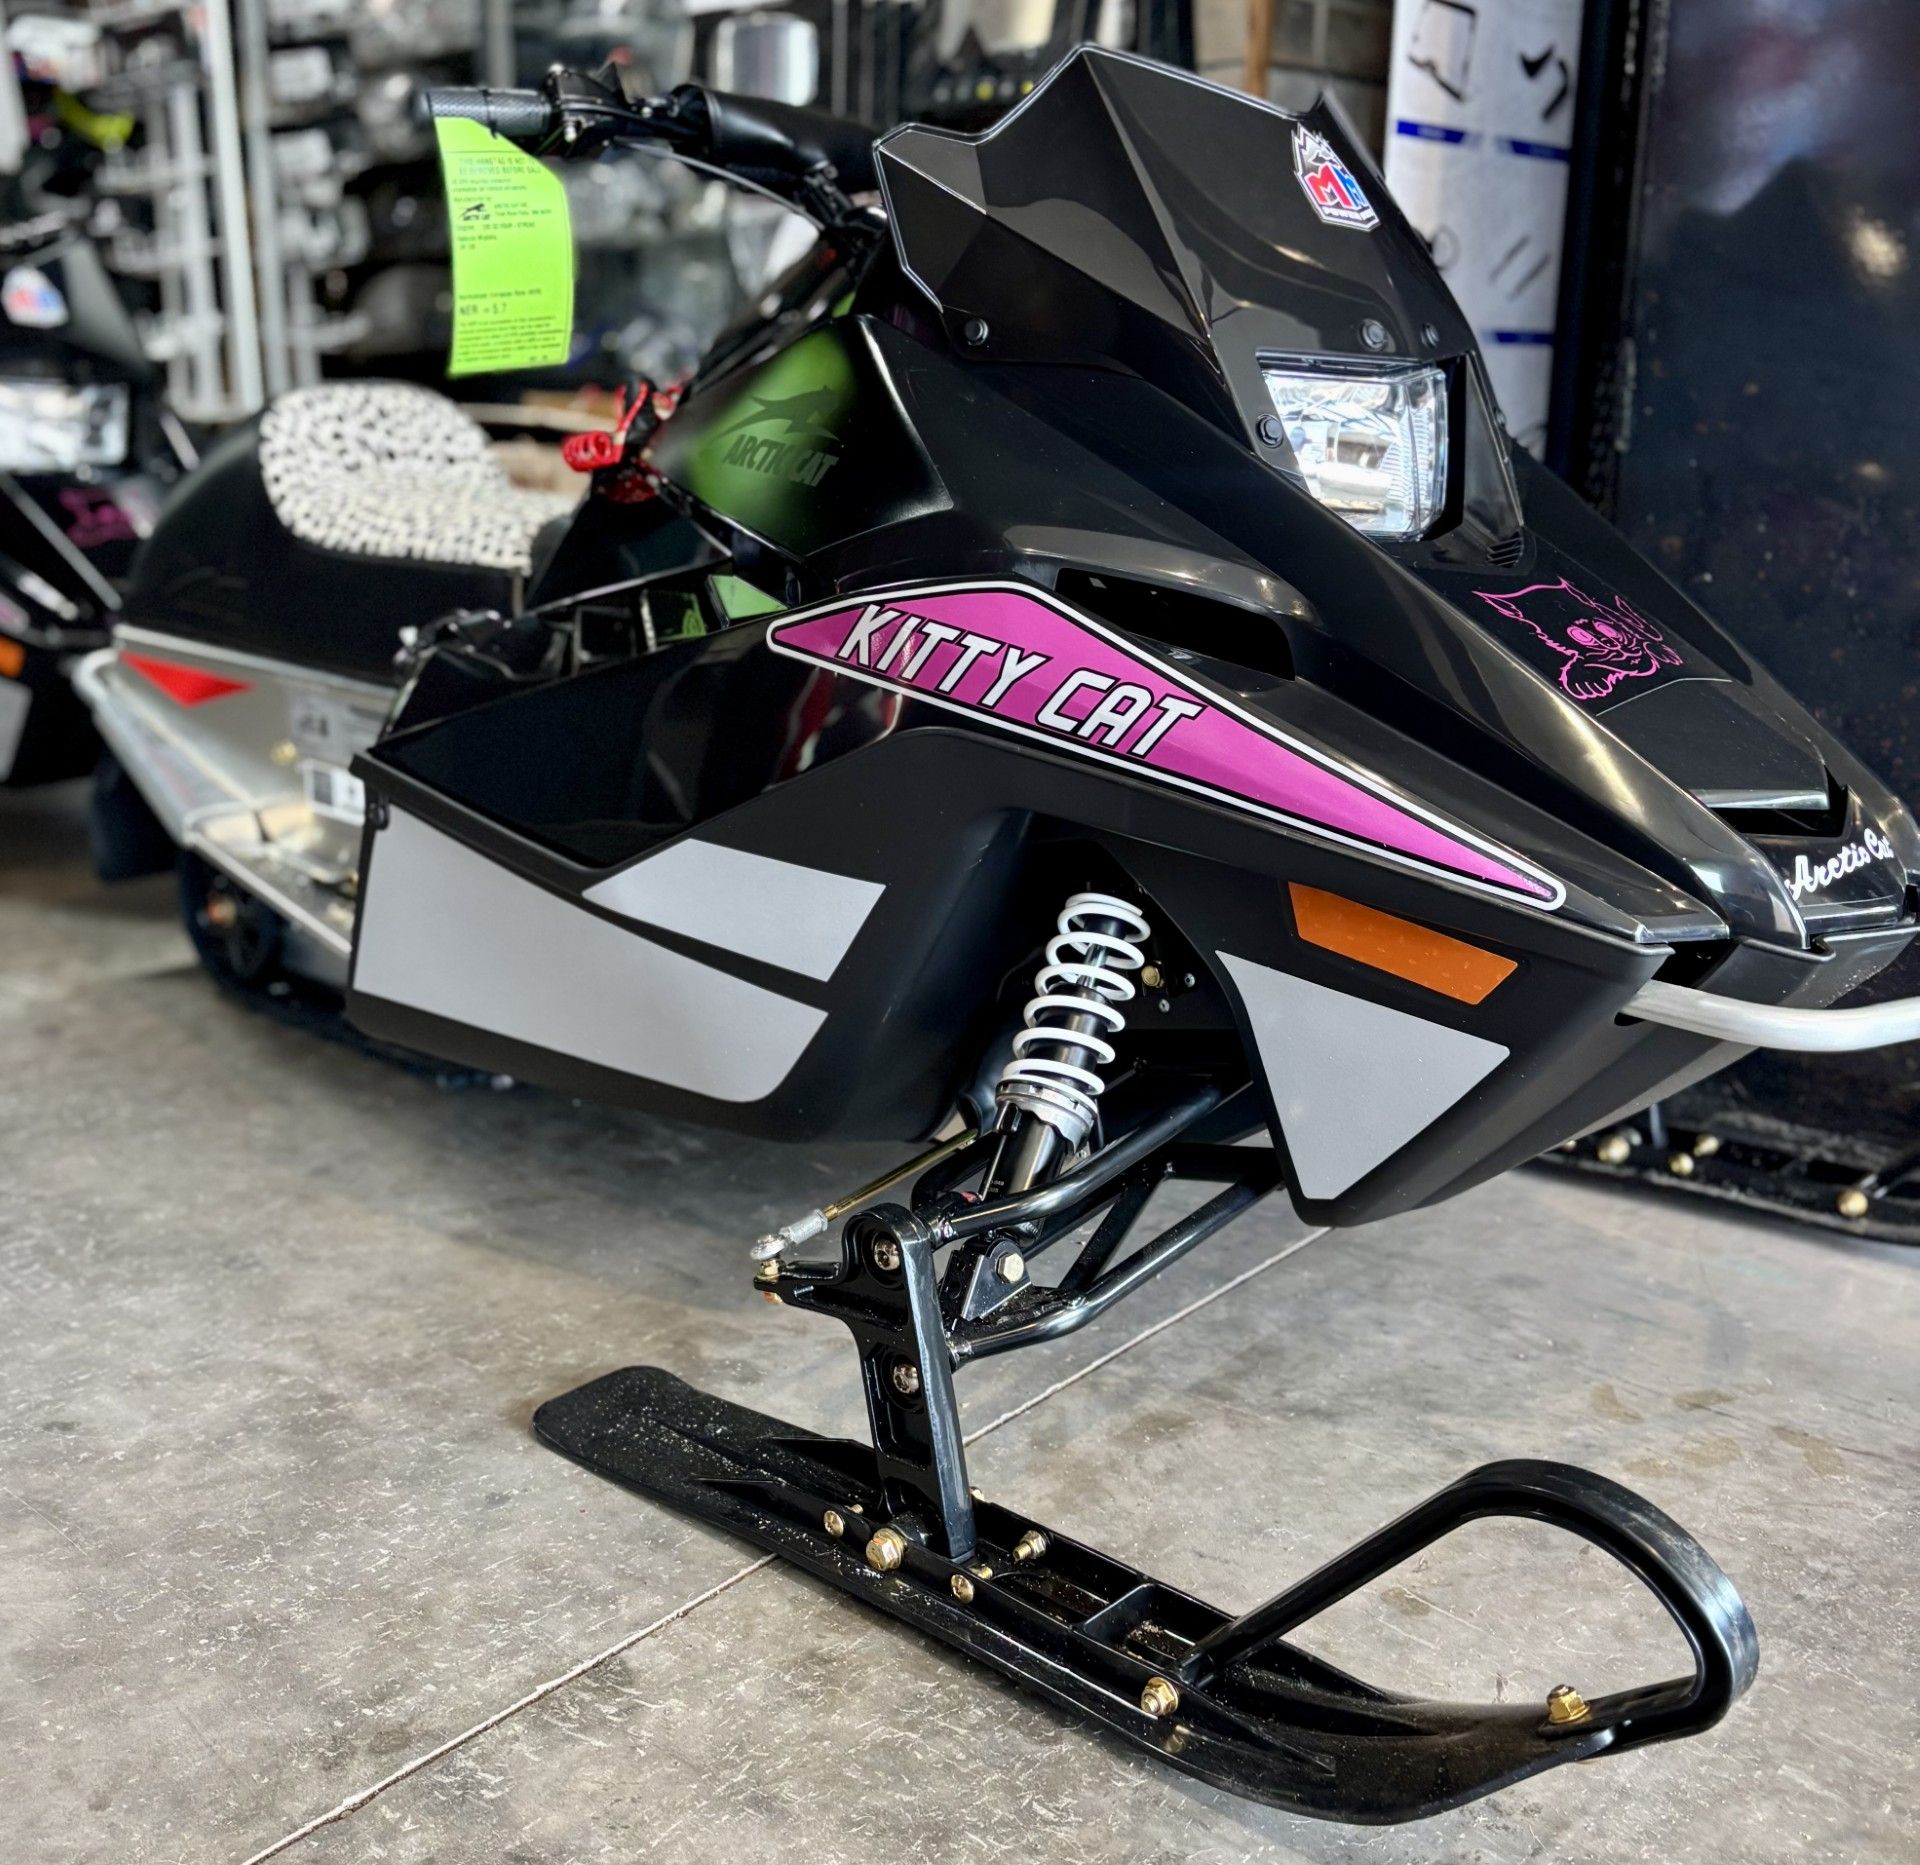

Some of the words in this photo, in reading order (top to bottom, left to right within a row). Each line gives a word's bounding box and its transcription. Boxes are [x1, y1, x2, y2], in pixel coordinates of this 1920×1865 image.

[722, 434, 794, 478] ARCTIC
[790, 449, 840, 487] CAT
[838, 604, 1049, 707] KITTY
[1036, 668, 1203, 757] CAT
[1783, 843, 1871, 901] Arctic
[1864, 827, 1895, 860] Cat
